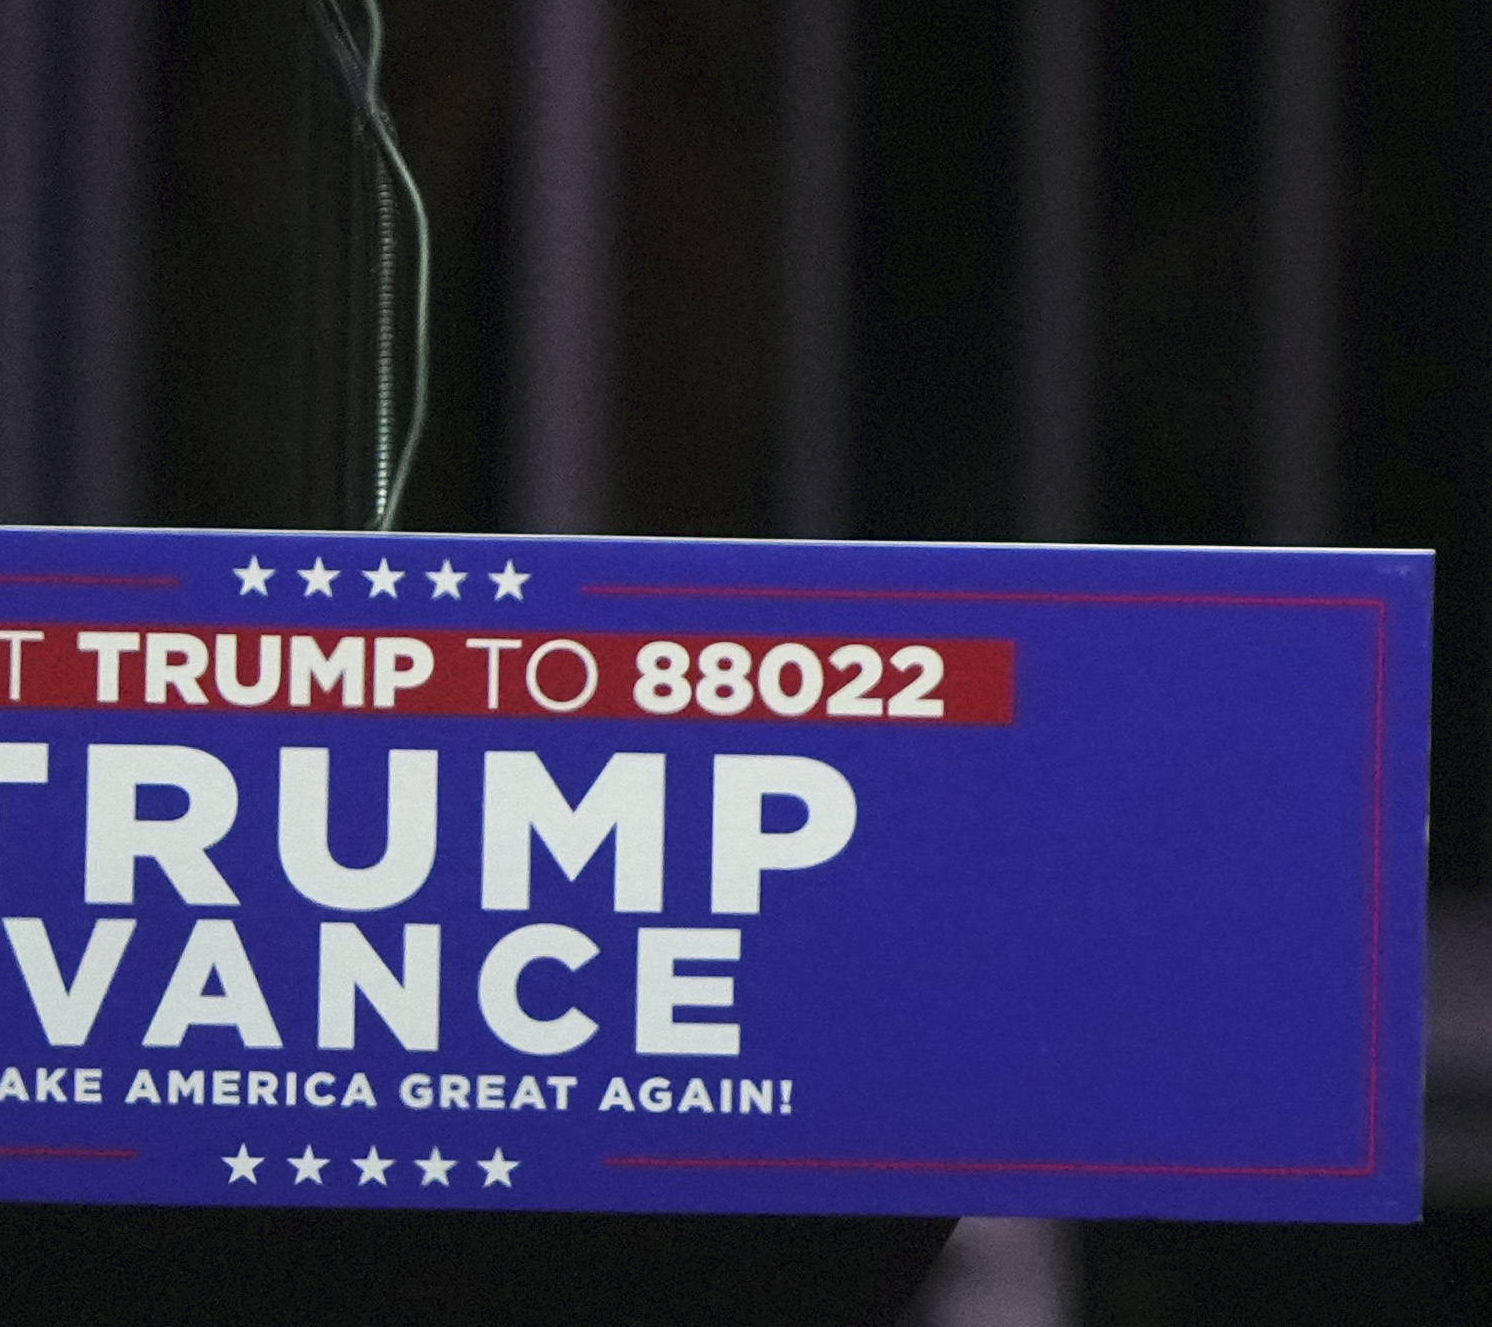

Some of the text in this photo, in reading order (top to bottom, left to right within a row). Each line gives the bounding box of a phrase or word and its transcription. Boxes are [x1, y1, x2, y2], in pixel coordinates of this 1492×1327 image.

[75, 630, 436, 710] TRUMP
[464, 637, 600, 713] TO
[631, 639, 946, 719] 88022
[0, 915, 743, 1058] VANCE
[123, 1067, 379, 1109] AMERICA
[398, 1072, 579, 1112] GREAT
[597, 1075, 794, 1116] AGAIN!
